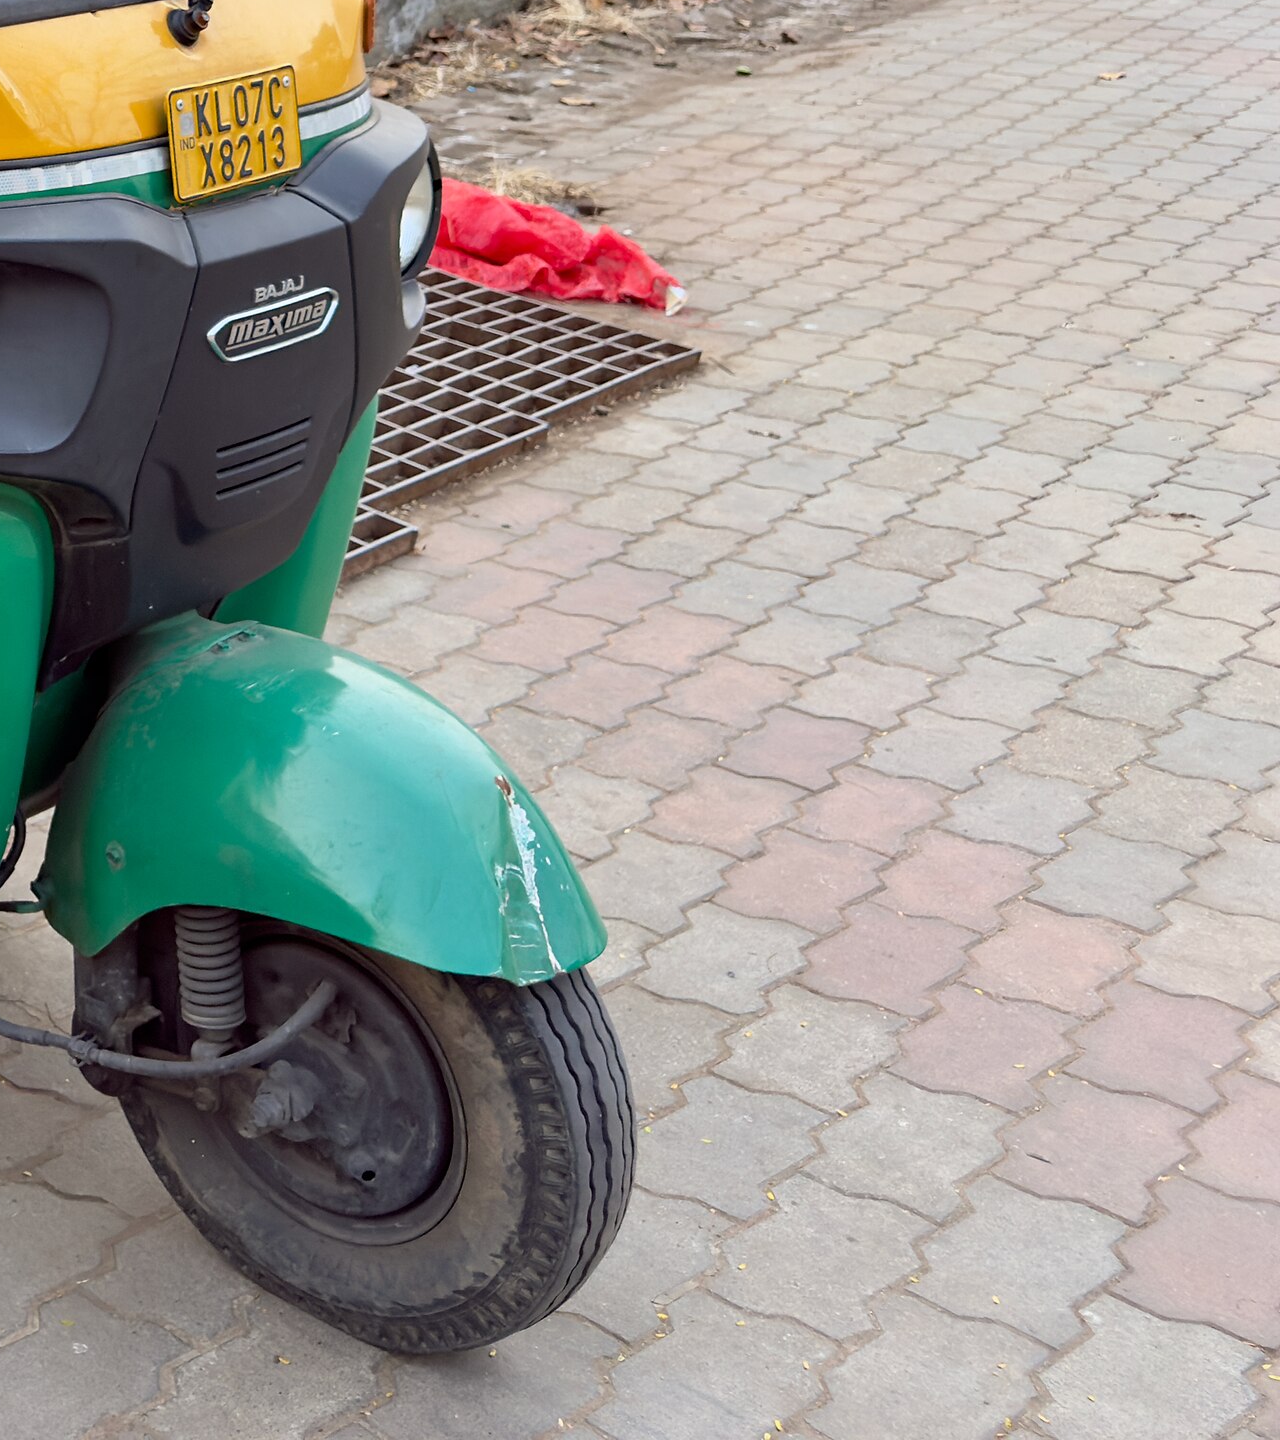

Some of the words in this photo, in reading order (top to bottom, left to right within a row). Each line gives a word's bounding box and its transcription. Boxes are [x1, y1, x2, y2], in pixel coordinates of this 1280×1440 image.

[195, 76, 283, 138] KL07C
[180, 137, 195, 151] IND
[200, 126, 285, 188] X8213
[255, 274, 305, 303] BAJAJ
